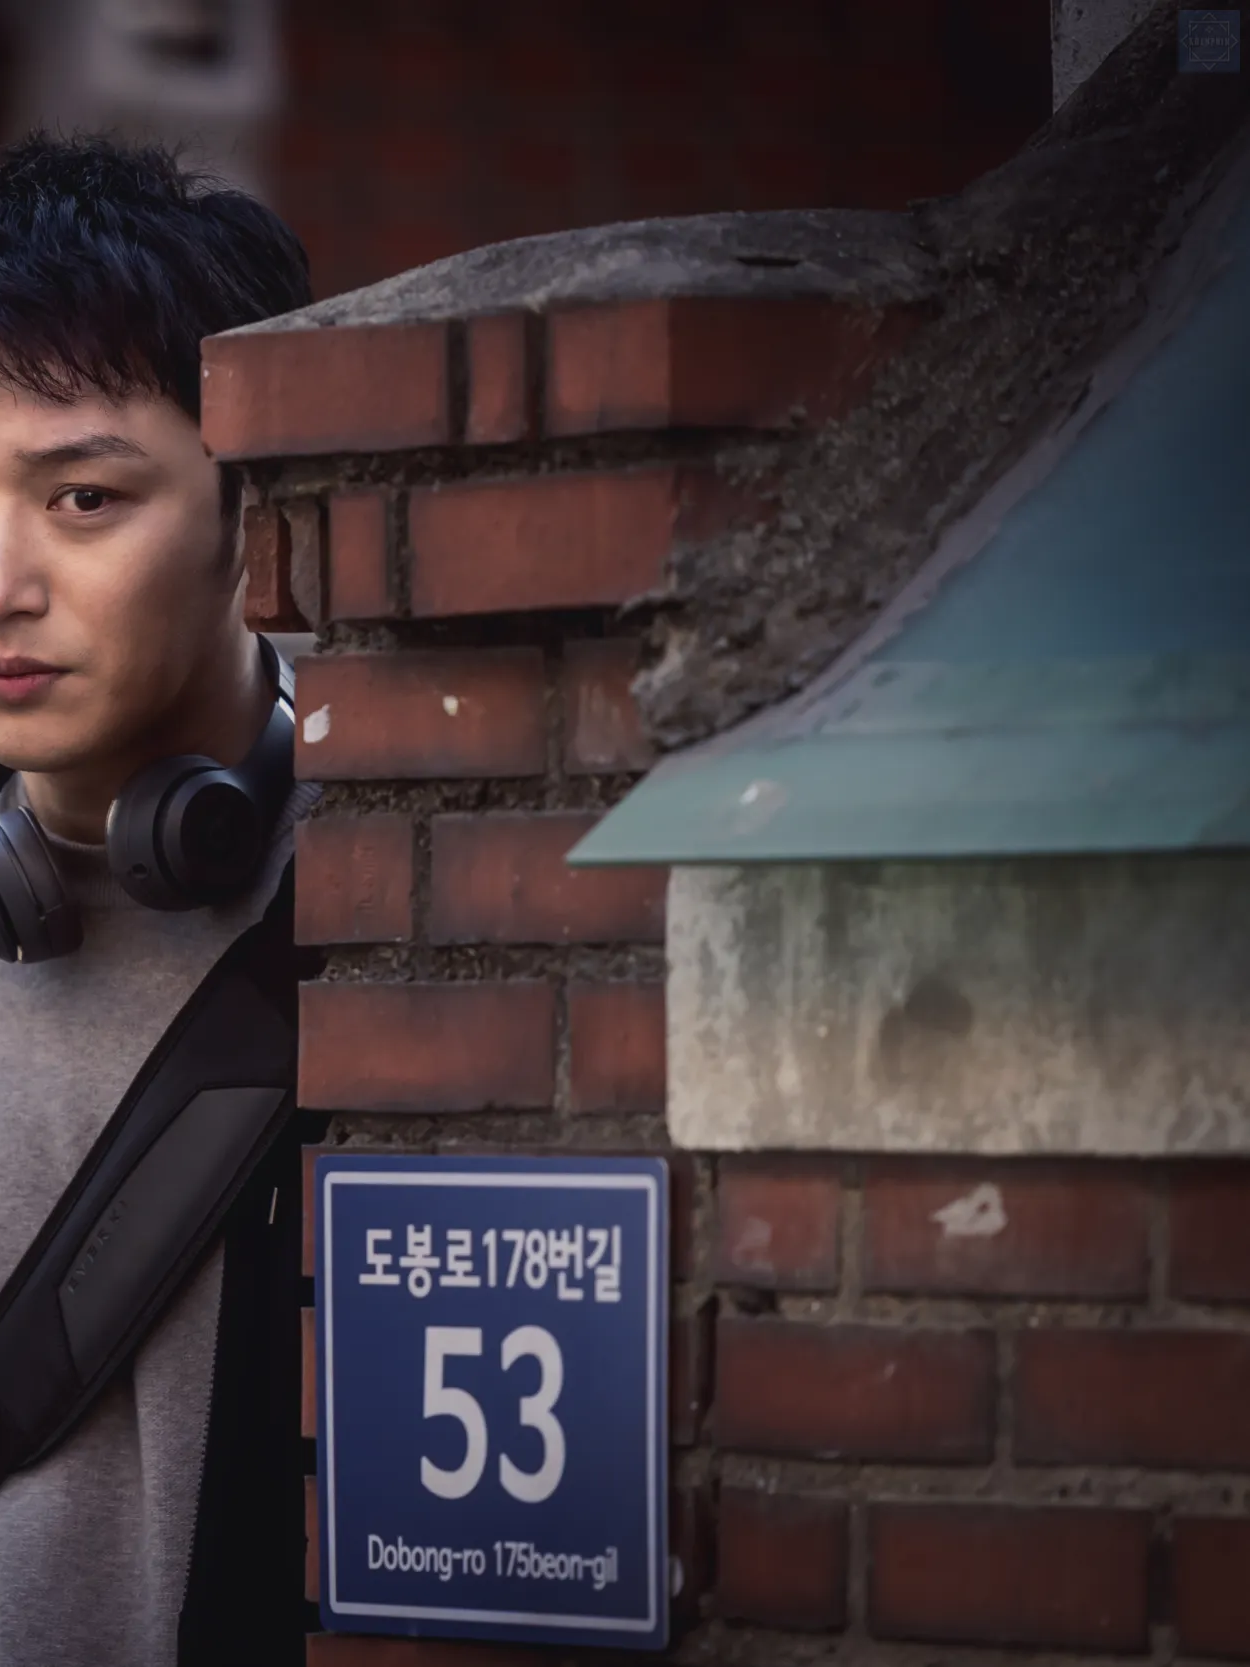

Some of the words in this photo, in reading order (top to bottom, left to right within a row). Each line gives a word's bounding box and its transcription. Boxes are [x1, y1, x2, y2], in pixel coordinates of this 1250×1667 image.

[359, 1225, 621, 1302] 도봉로178번길
[420, 1325, 566, 1503] 53
[368, 1534, 486, 1581] Dobong-ro
[493, 1541, 618, 1590] 175beon-gil
